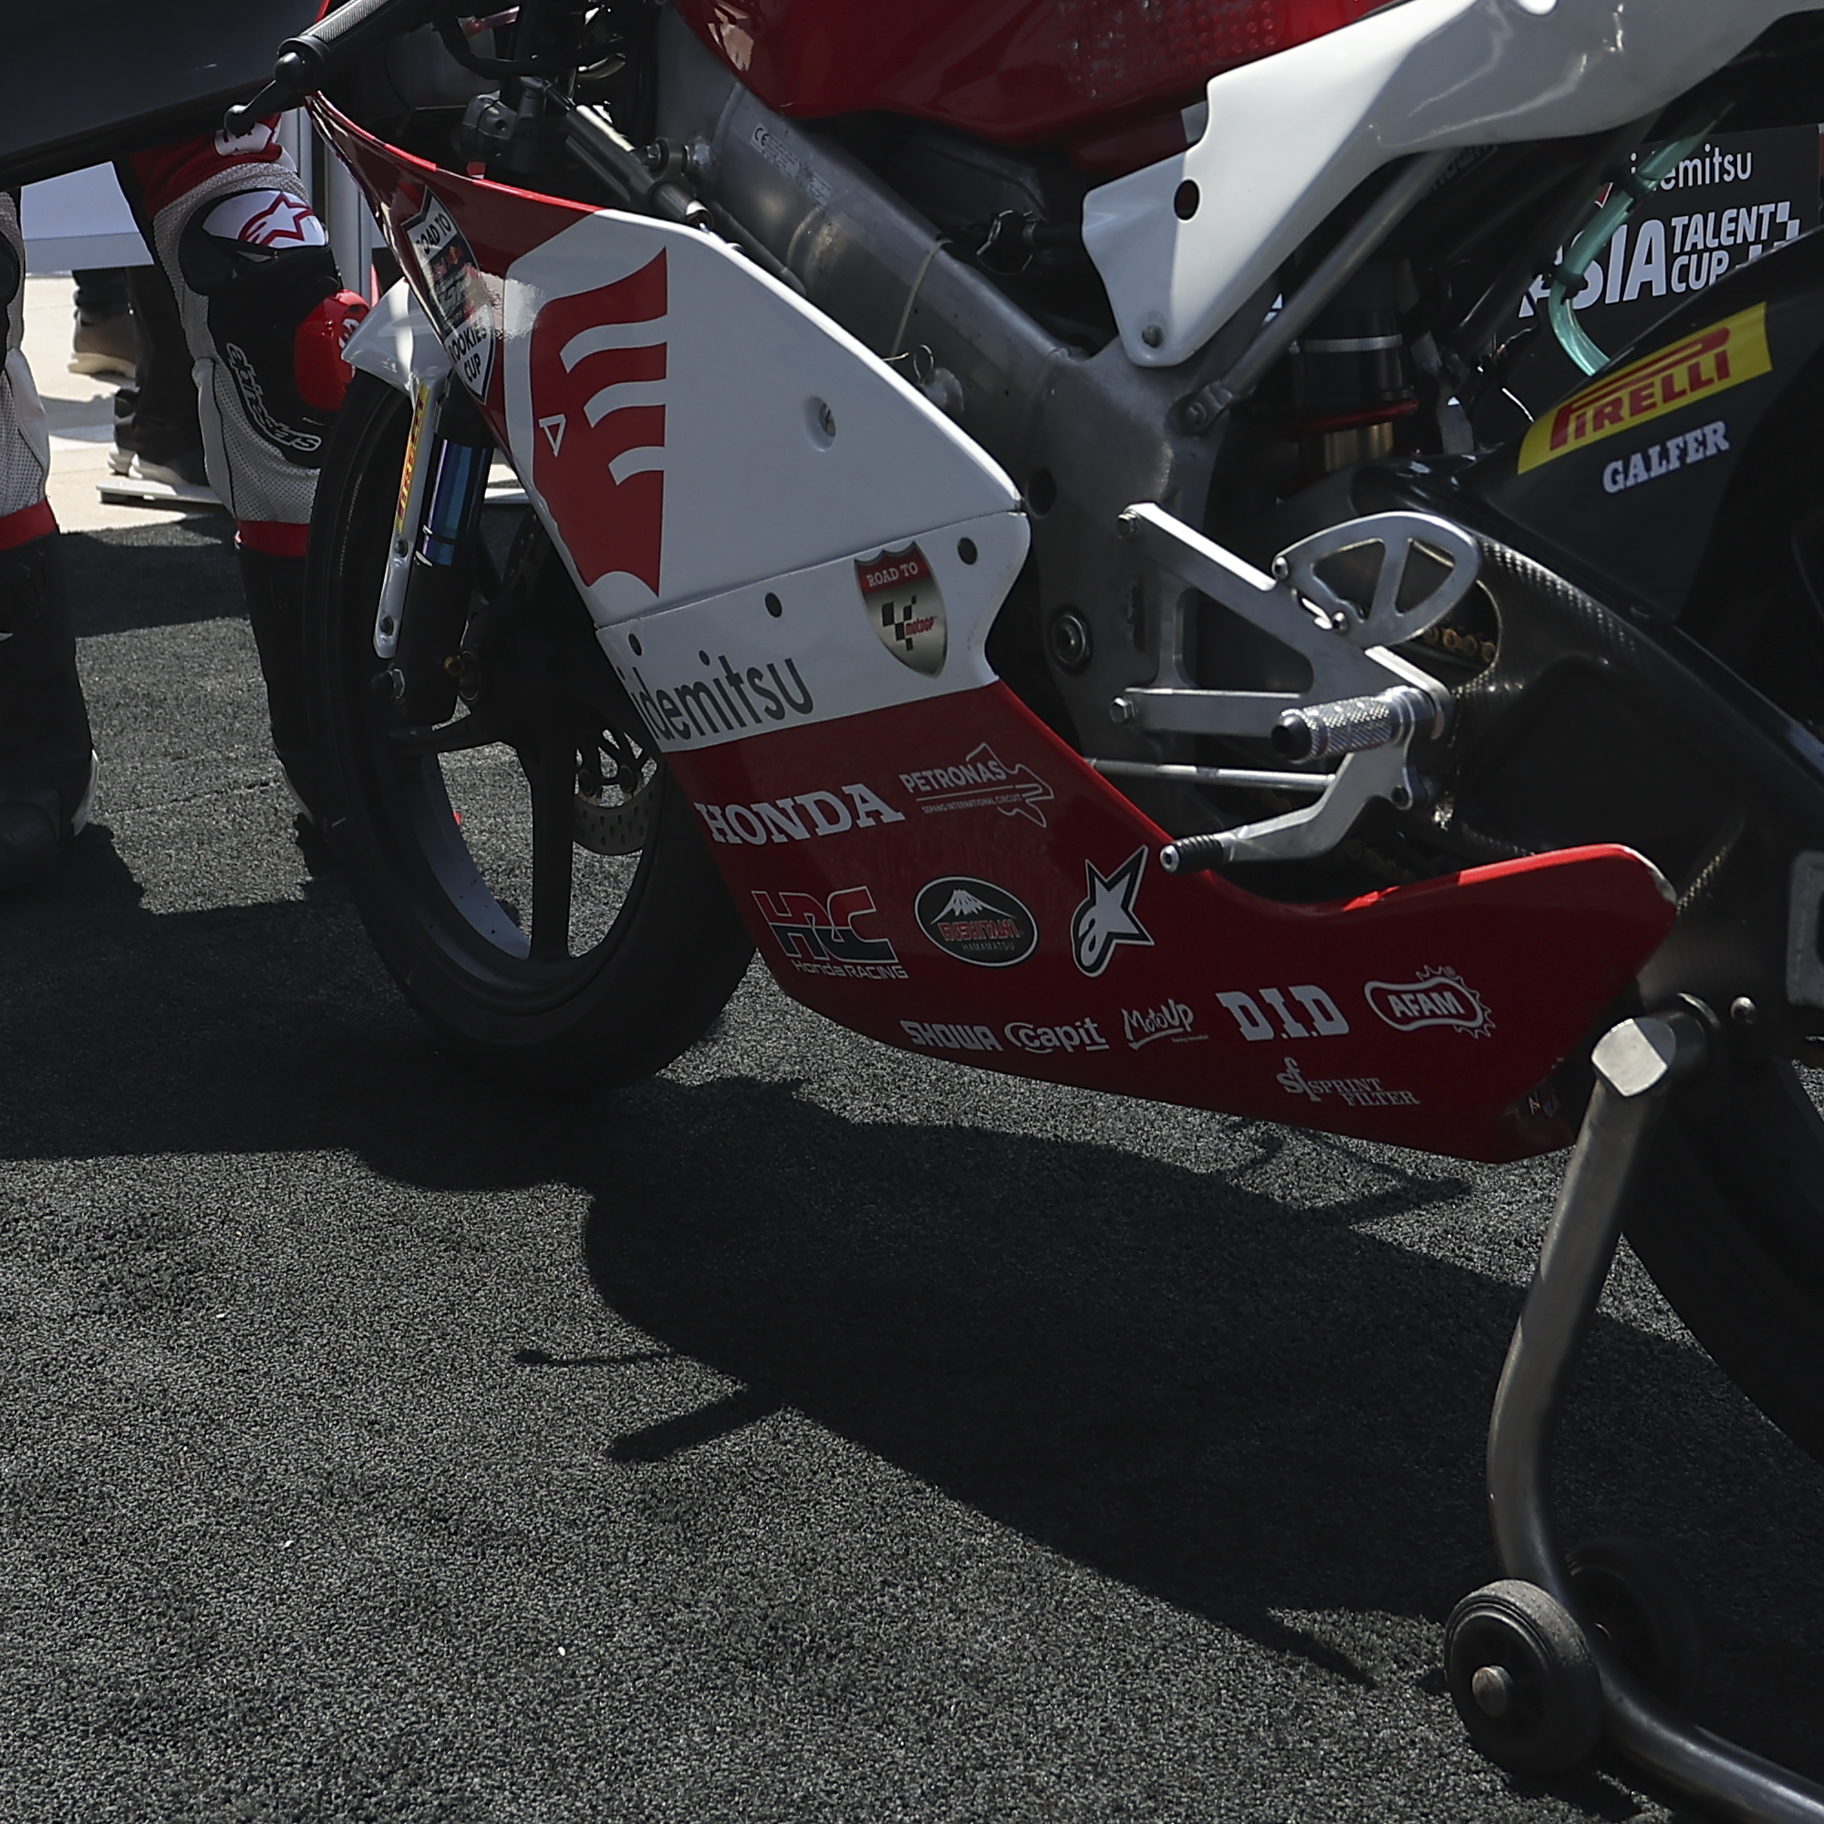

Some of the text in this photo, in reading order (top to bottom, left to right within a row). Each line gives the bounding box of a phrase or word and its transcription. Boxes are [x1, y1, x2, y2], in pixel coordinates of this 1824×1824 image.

[1671, 201, 1776, 254] TALENT
[1671, 249, 1731, 294] CUP
[463, 355, 482, 384] CUP
[1549, 326, 1732, 452] PIRELLI
[1602, 419, 1731, 495] GALFER
[866, 561, 919, 588] ROAD TO
[617, 650, 814, 741] idemitsu
[898, 759, 1008, 793] PETRONAS
[693, 782, 907, 846] HONDA
[947, 796, 996, 812] INTERNATIONAL
[996, 792, 1023, 806] CIRCUIT
[751, 885, 899, 965] HRC
[961, 940, 1016, 953] HAMAMATSU
[1386, 987, 1467, 1020] AFAM
[900, 1019, 1004, 1052] SHOWA
[1307, 1077, 1384, 1095] SPRINT
[1340, 1090, 1421, 1107] FILTER
